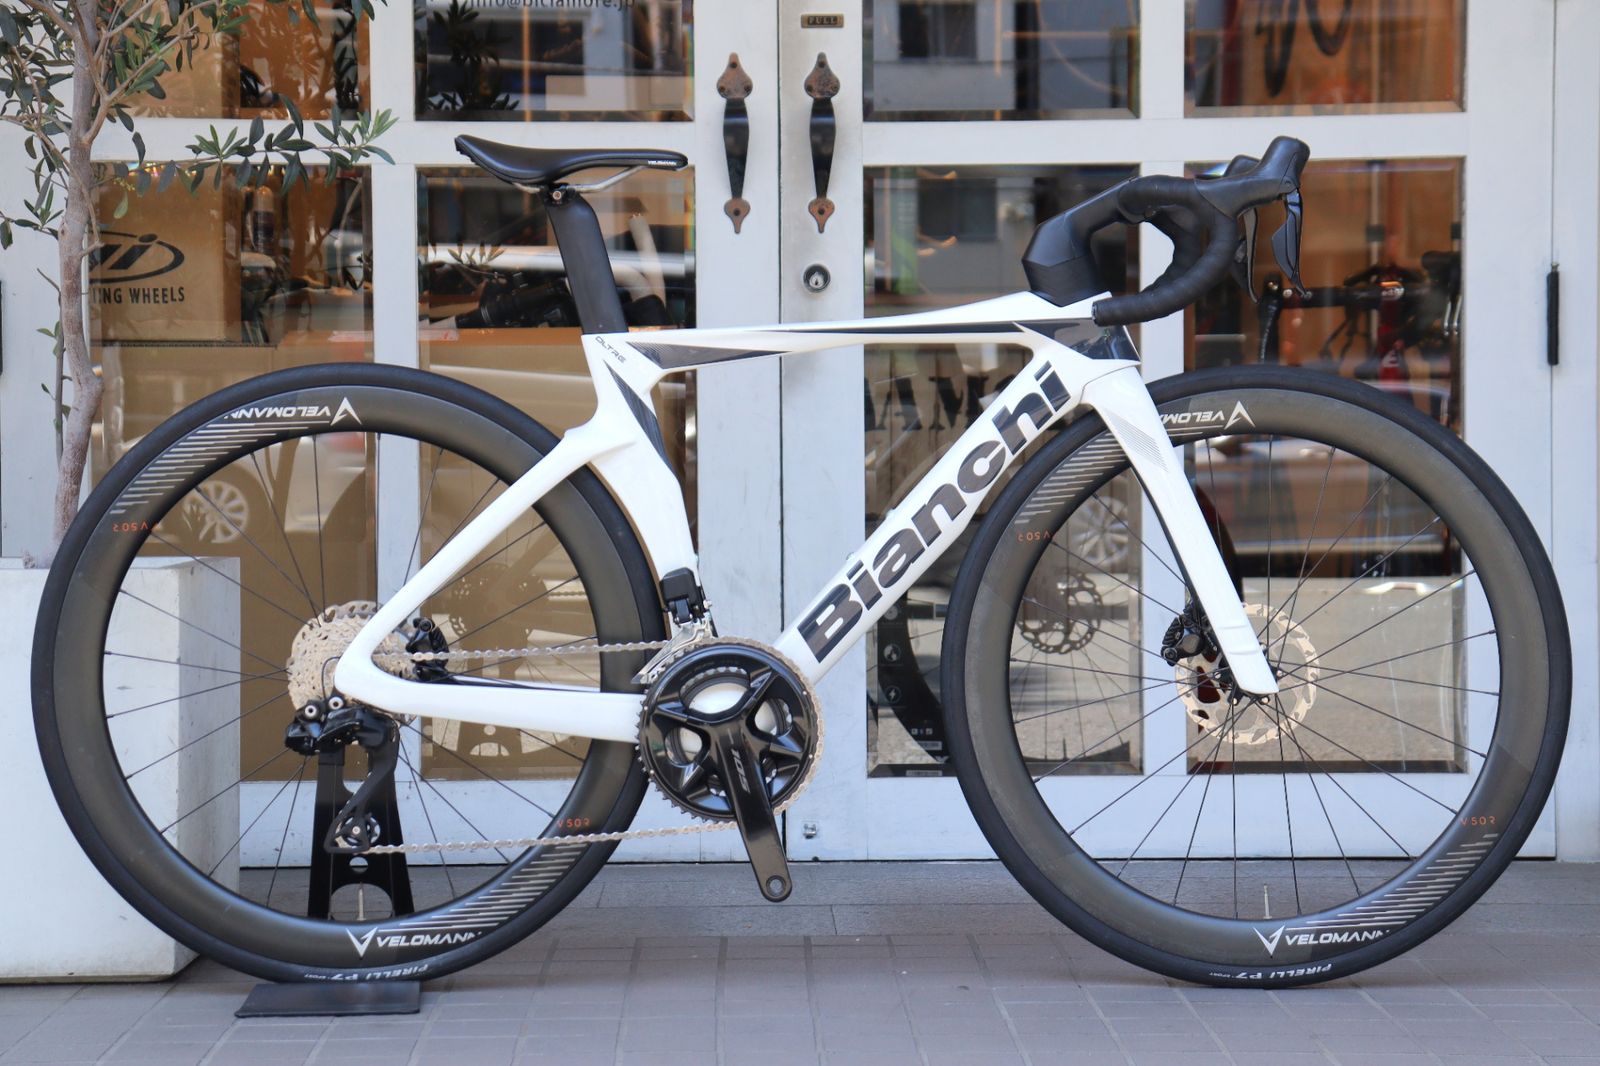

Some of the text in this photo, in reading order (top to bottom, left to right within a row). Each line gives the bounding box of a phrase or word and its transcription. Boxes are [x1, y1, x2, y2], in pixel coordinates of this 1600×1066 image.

[92, 286, 185, 304] ING WHEELS
[595, 336, 627, 363] OLTRE
[797, 360, 1072, 664] Bianchi
[365, 964, 429, 980] PIRELLI
[1269, 963, 1332, 979] PIRELLI
